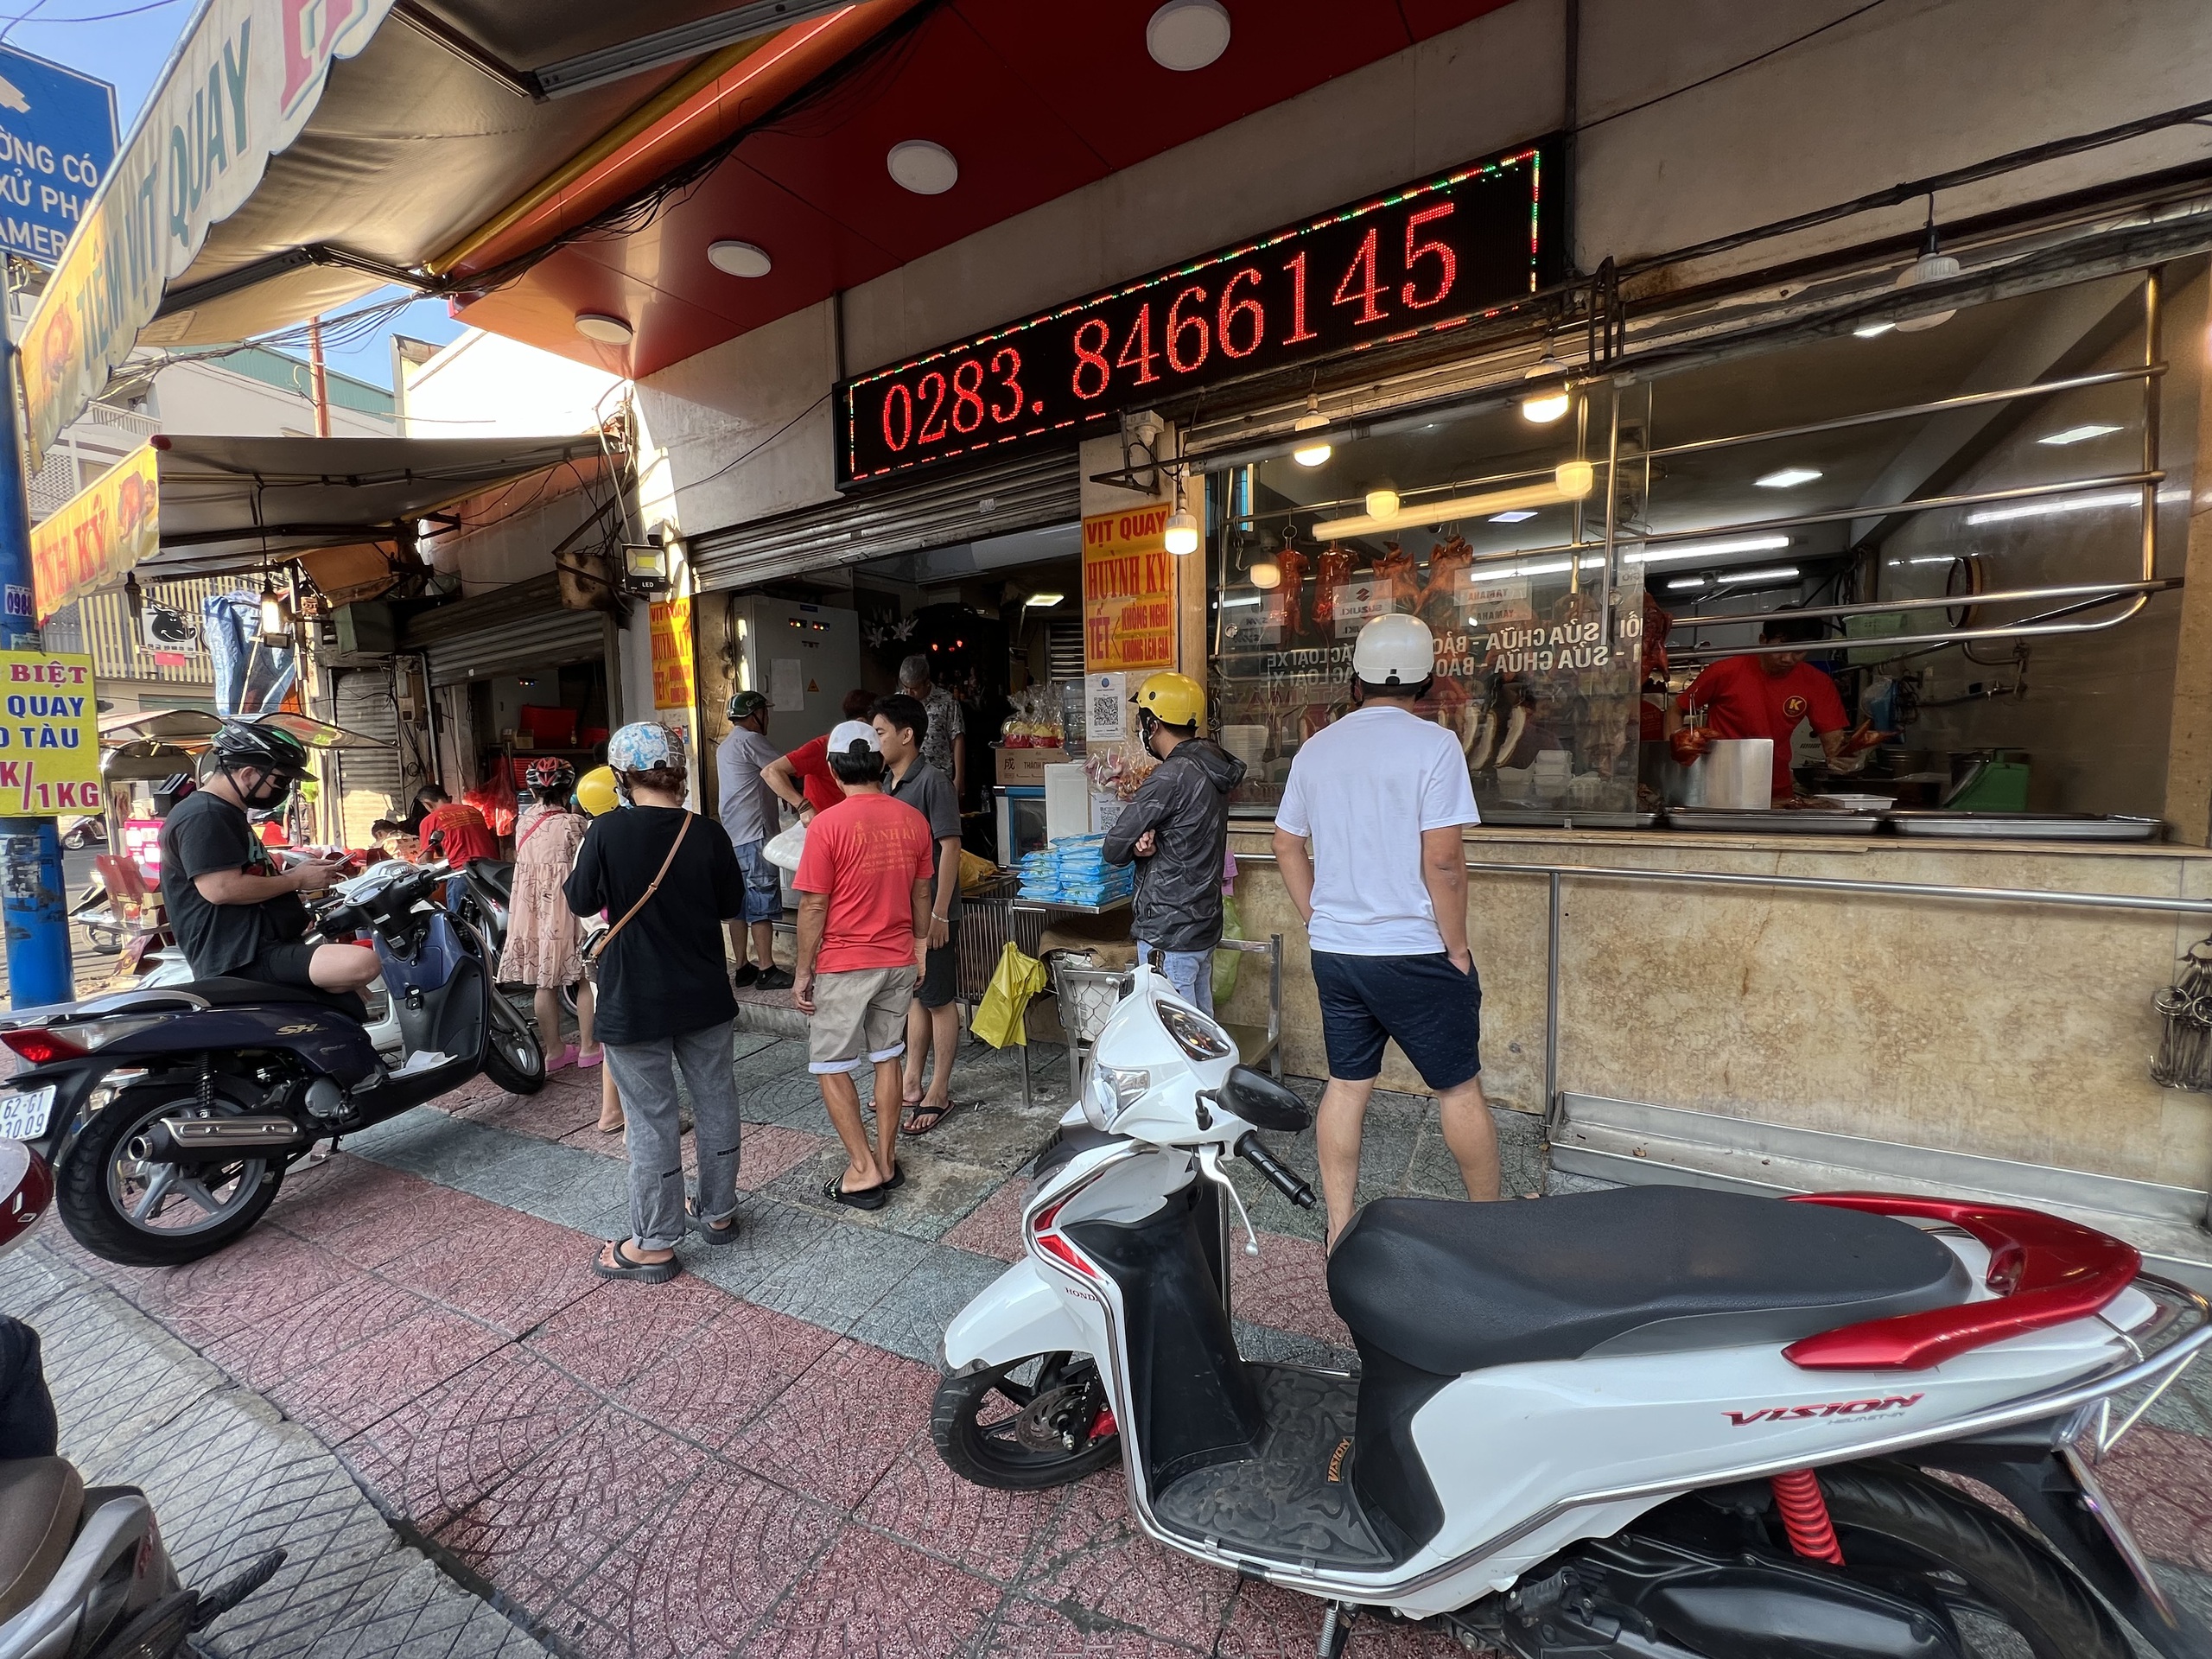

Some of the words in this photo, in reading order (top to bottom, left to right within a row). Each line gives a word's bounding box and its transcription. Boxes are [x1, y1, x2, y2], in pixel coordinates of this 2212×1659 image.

[63, 153, 98, 188] CÓ
[124, 161, 157, 308] VỊT
[169, 15, 251, 248] QUAY
[41, 185, 90, 221] PH
[882, 347, 1044, 453] 0283.
[1072, 202, 1457, 401] 8466145
[1086, 519, 1114, 548] VỊT
[1120, 511, 1166, 541] QUAY
[1087, 550, 1140, 601] HUỲNH
[651, 607, 664, 625] VỊT
[1089, 602, 1110, 659] TẾT
[1122, 602, 1147, 631] KHÔNG
[1122, 635, 1143, 663] KHÔNG
[10, 661, 87, 688] BIỆT
[8, 695, 85, 719] QUAY
[1789, 698, 1803, 711] K
[20, 723, 79, 749] TÀU
[275, 1023, 318, 1035] SH
[0, 1113, 45, 1139] 30.09
[1720, 1392, 1926, 1427] VISION
[1327, 1437, 1351, 1482] VISION
